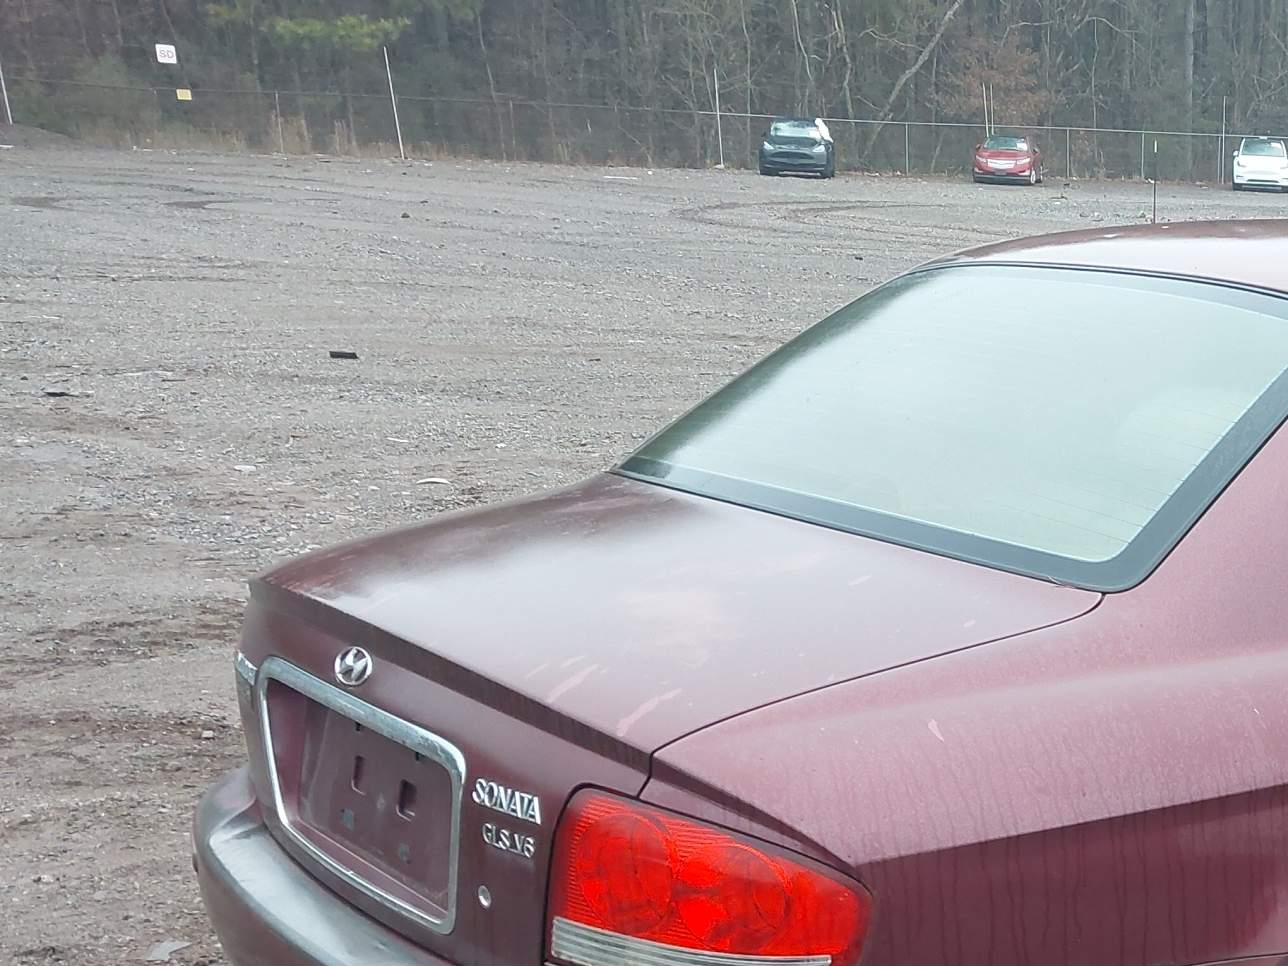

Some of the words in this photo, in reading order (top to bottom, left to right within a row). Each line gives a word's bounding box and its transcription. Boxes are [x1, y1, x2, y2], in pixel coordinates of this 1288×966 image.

[472, 778, 541, 825] SONATA
[482, 823, 511, 850] GLS
[513, 833, 535, 858] V6
